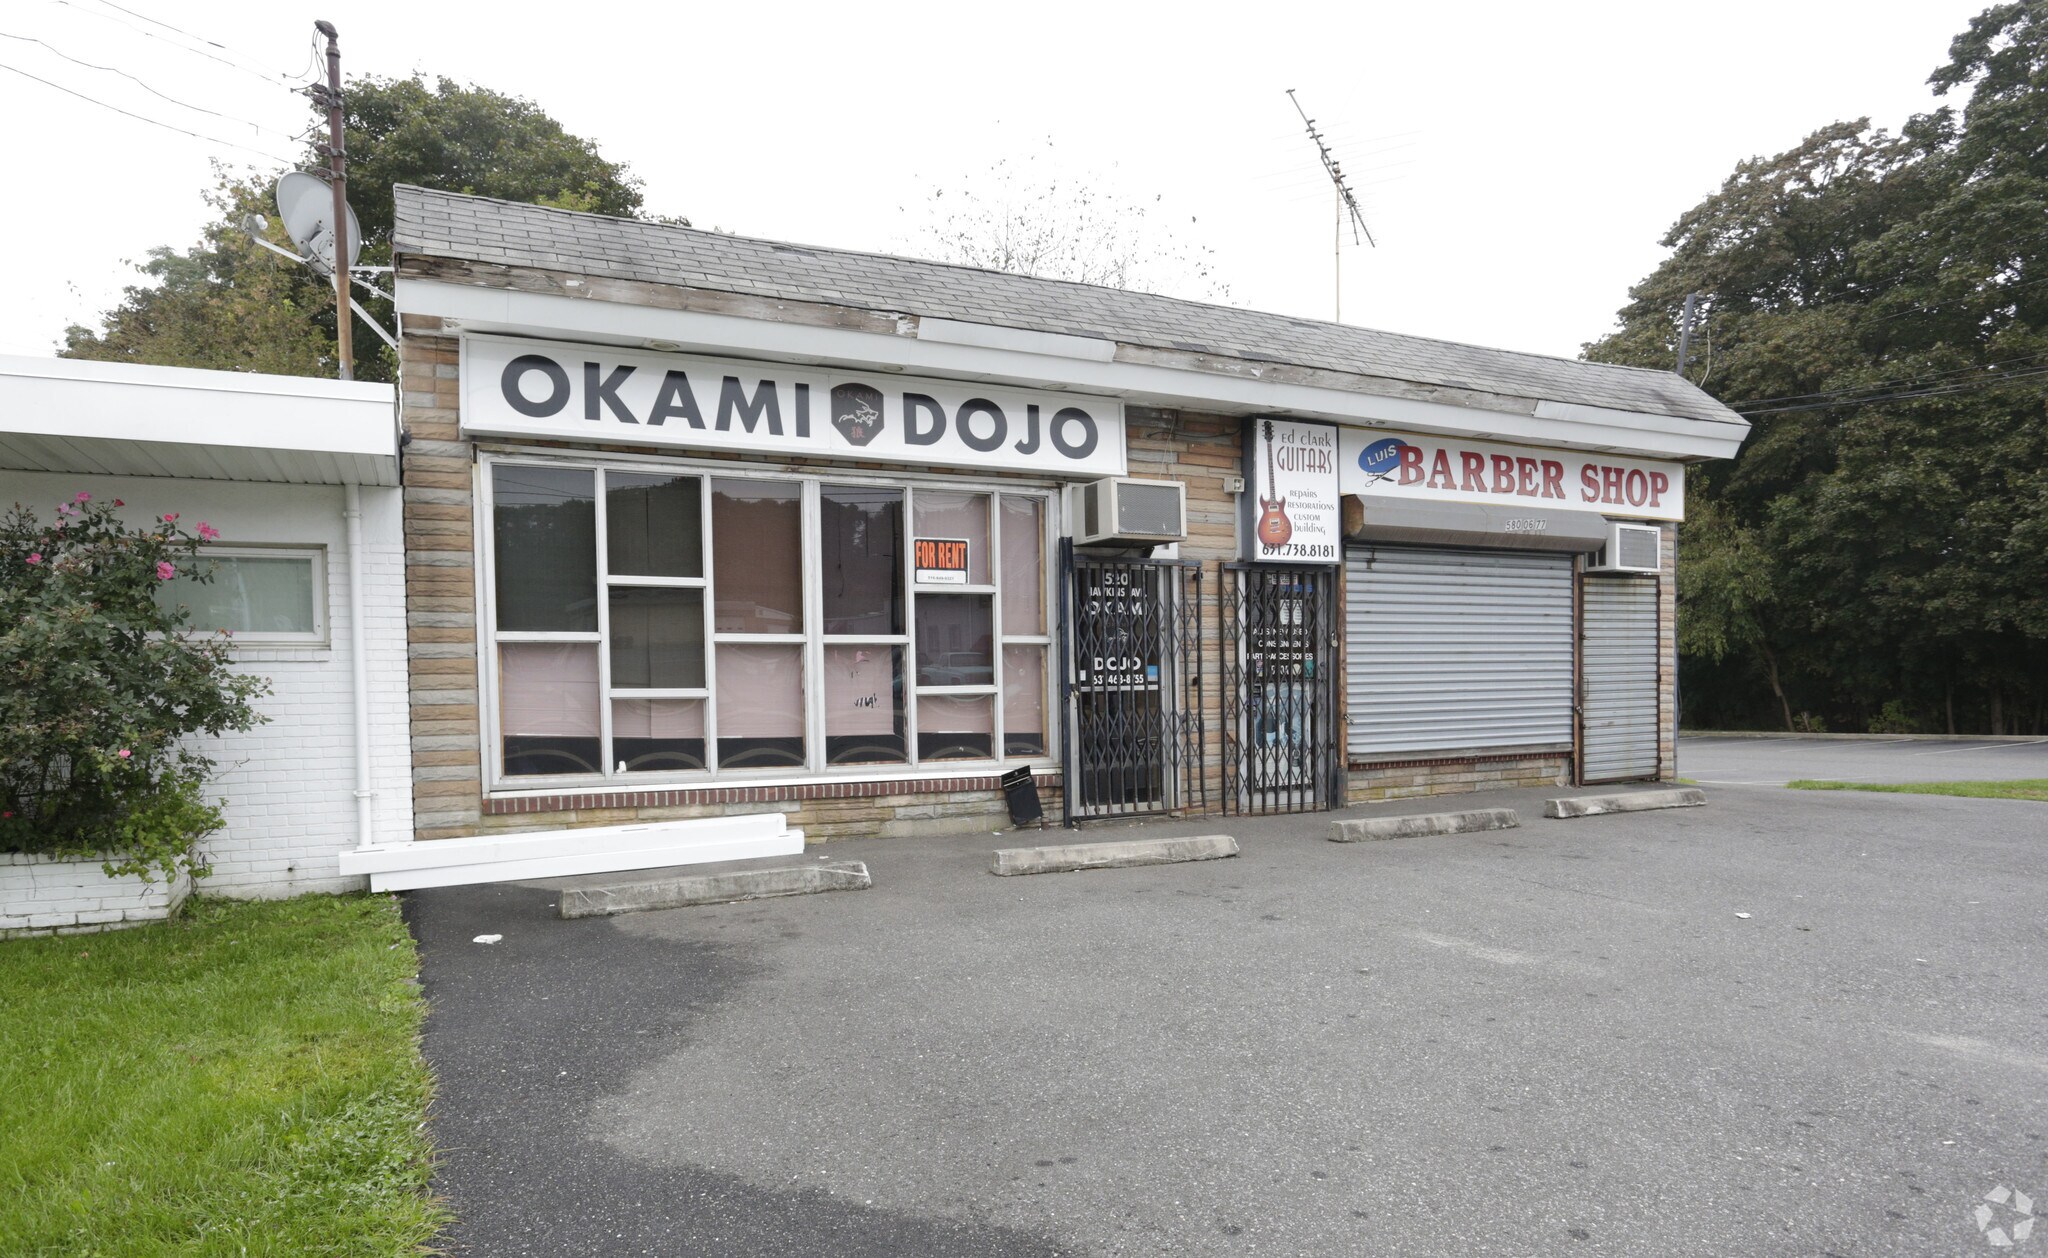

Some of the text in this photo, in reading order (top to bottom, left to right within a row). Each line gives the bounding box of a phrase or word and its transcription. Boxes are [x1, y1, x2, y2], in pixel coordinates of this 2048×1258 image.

[836, 389, 878, 401] OKAMI
[501, 354, 1098, 459] OKAMI DOJO
[1281, 429, 1295, 444] Ed
[1277, 446, 1332, 474] GUITARS
[1367, 444, 1669, 508] LUIS BARBER SHOP
[1506, 519, 1521, 530] 580
[915, 541, 966, 569] FOR RENT
[1262, 543, 1335, 558] 631.738.8181
